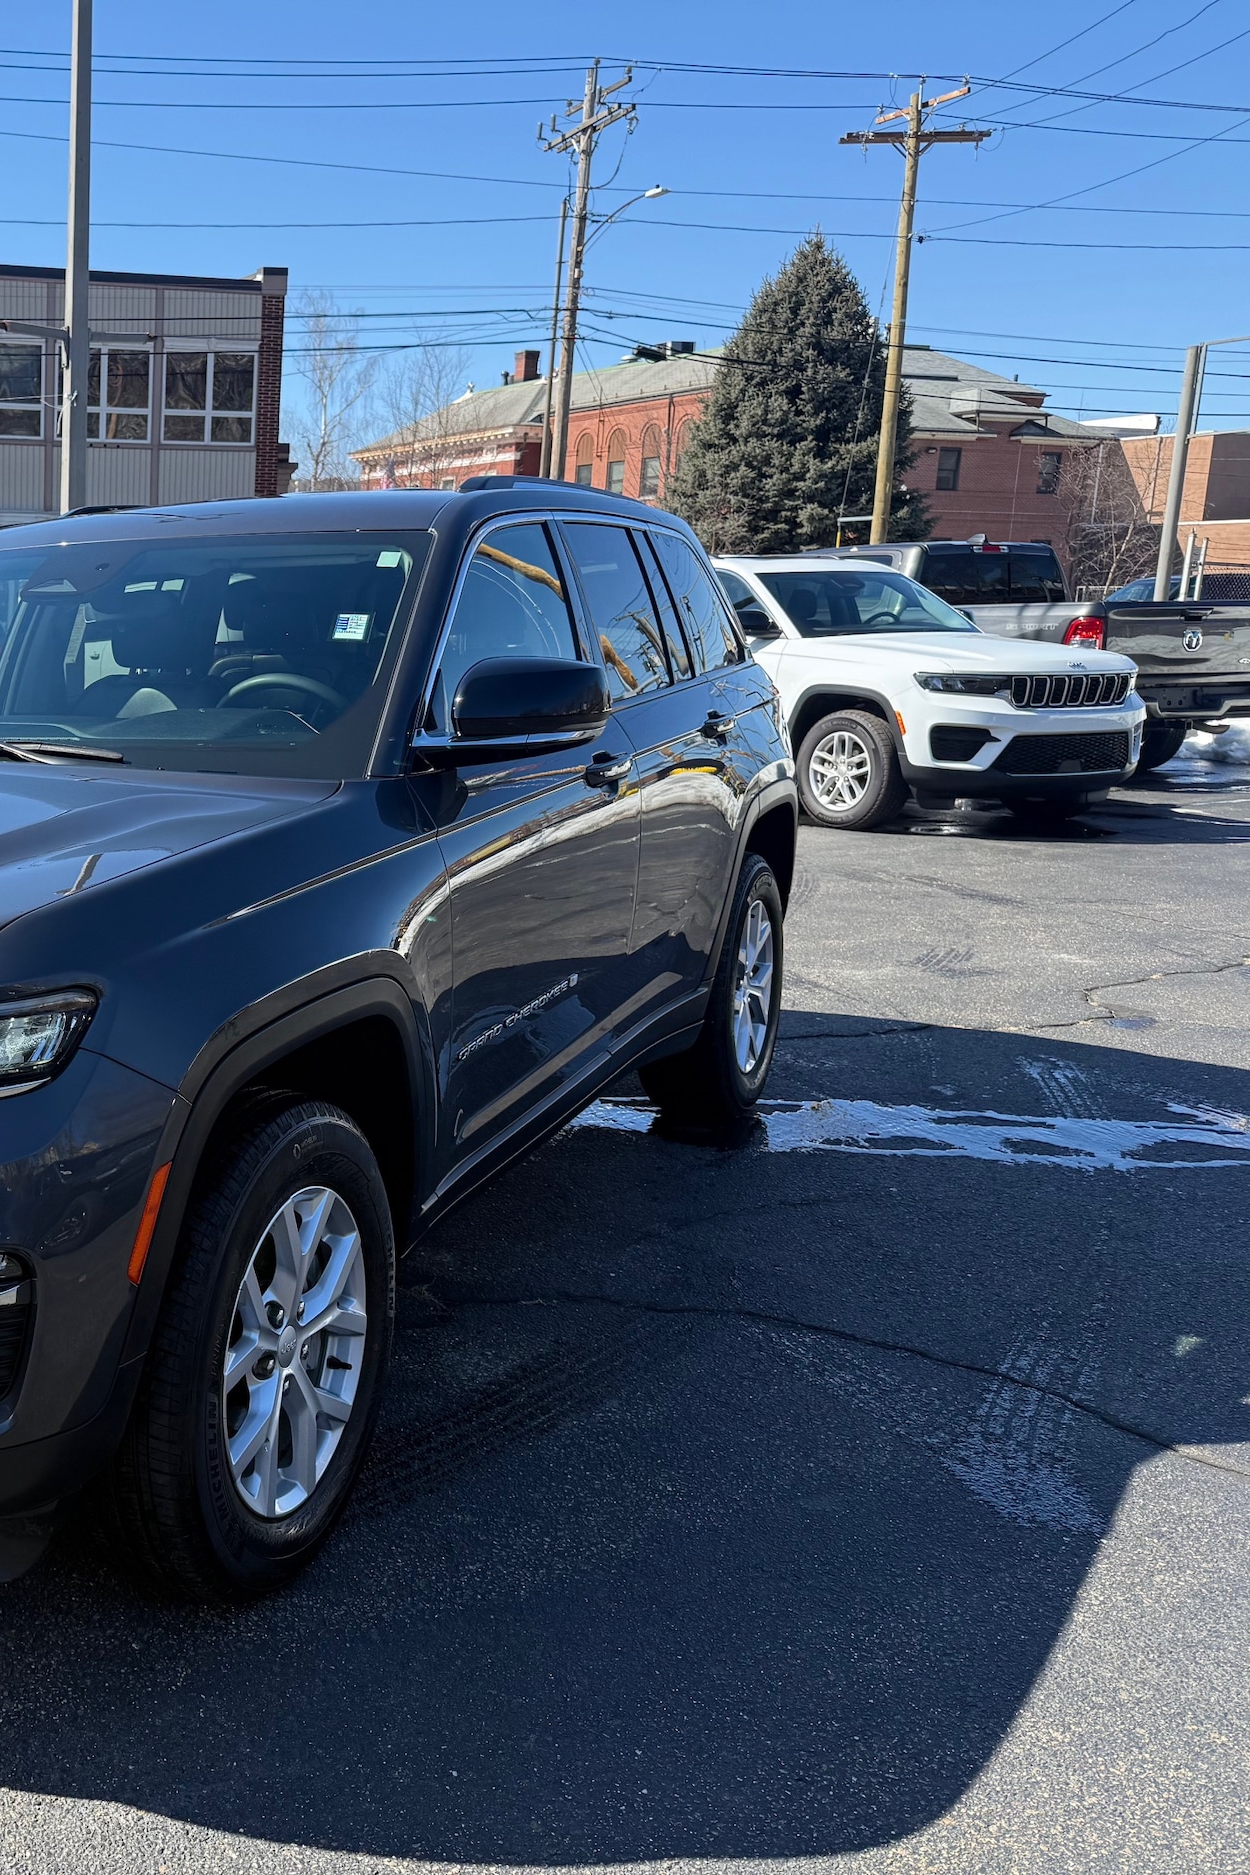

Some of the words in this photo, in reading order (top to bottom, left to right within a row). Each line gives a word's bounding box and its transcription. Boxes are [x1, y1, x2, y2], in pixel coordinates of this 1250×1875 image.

[456, 1022, 504, 1061] GRAND
[504, 979, 570, 1028] CHEROKEE
[206, 1399, 230, 1522] MICHELIN
